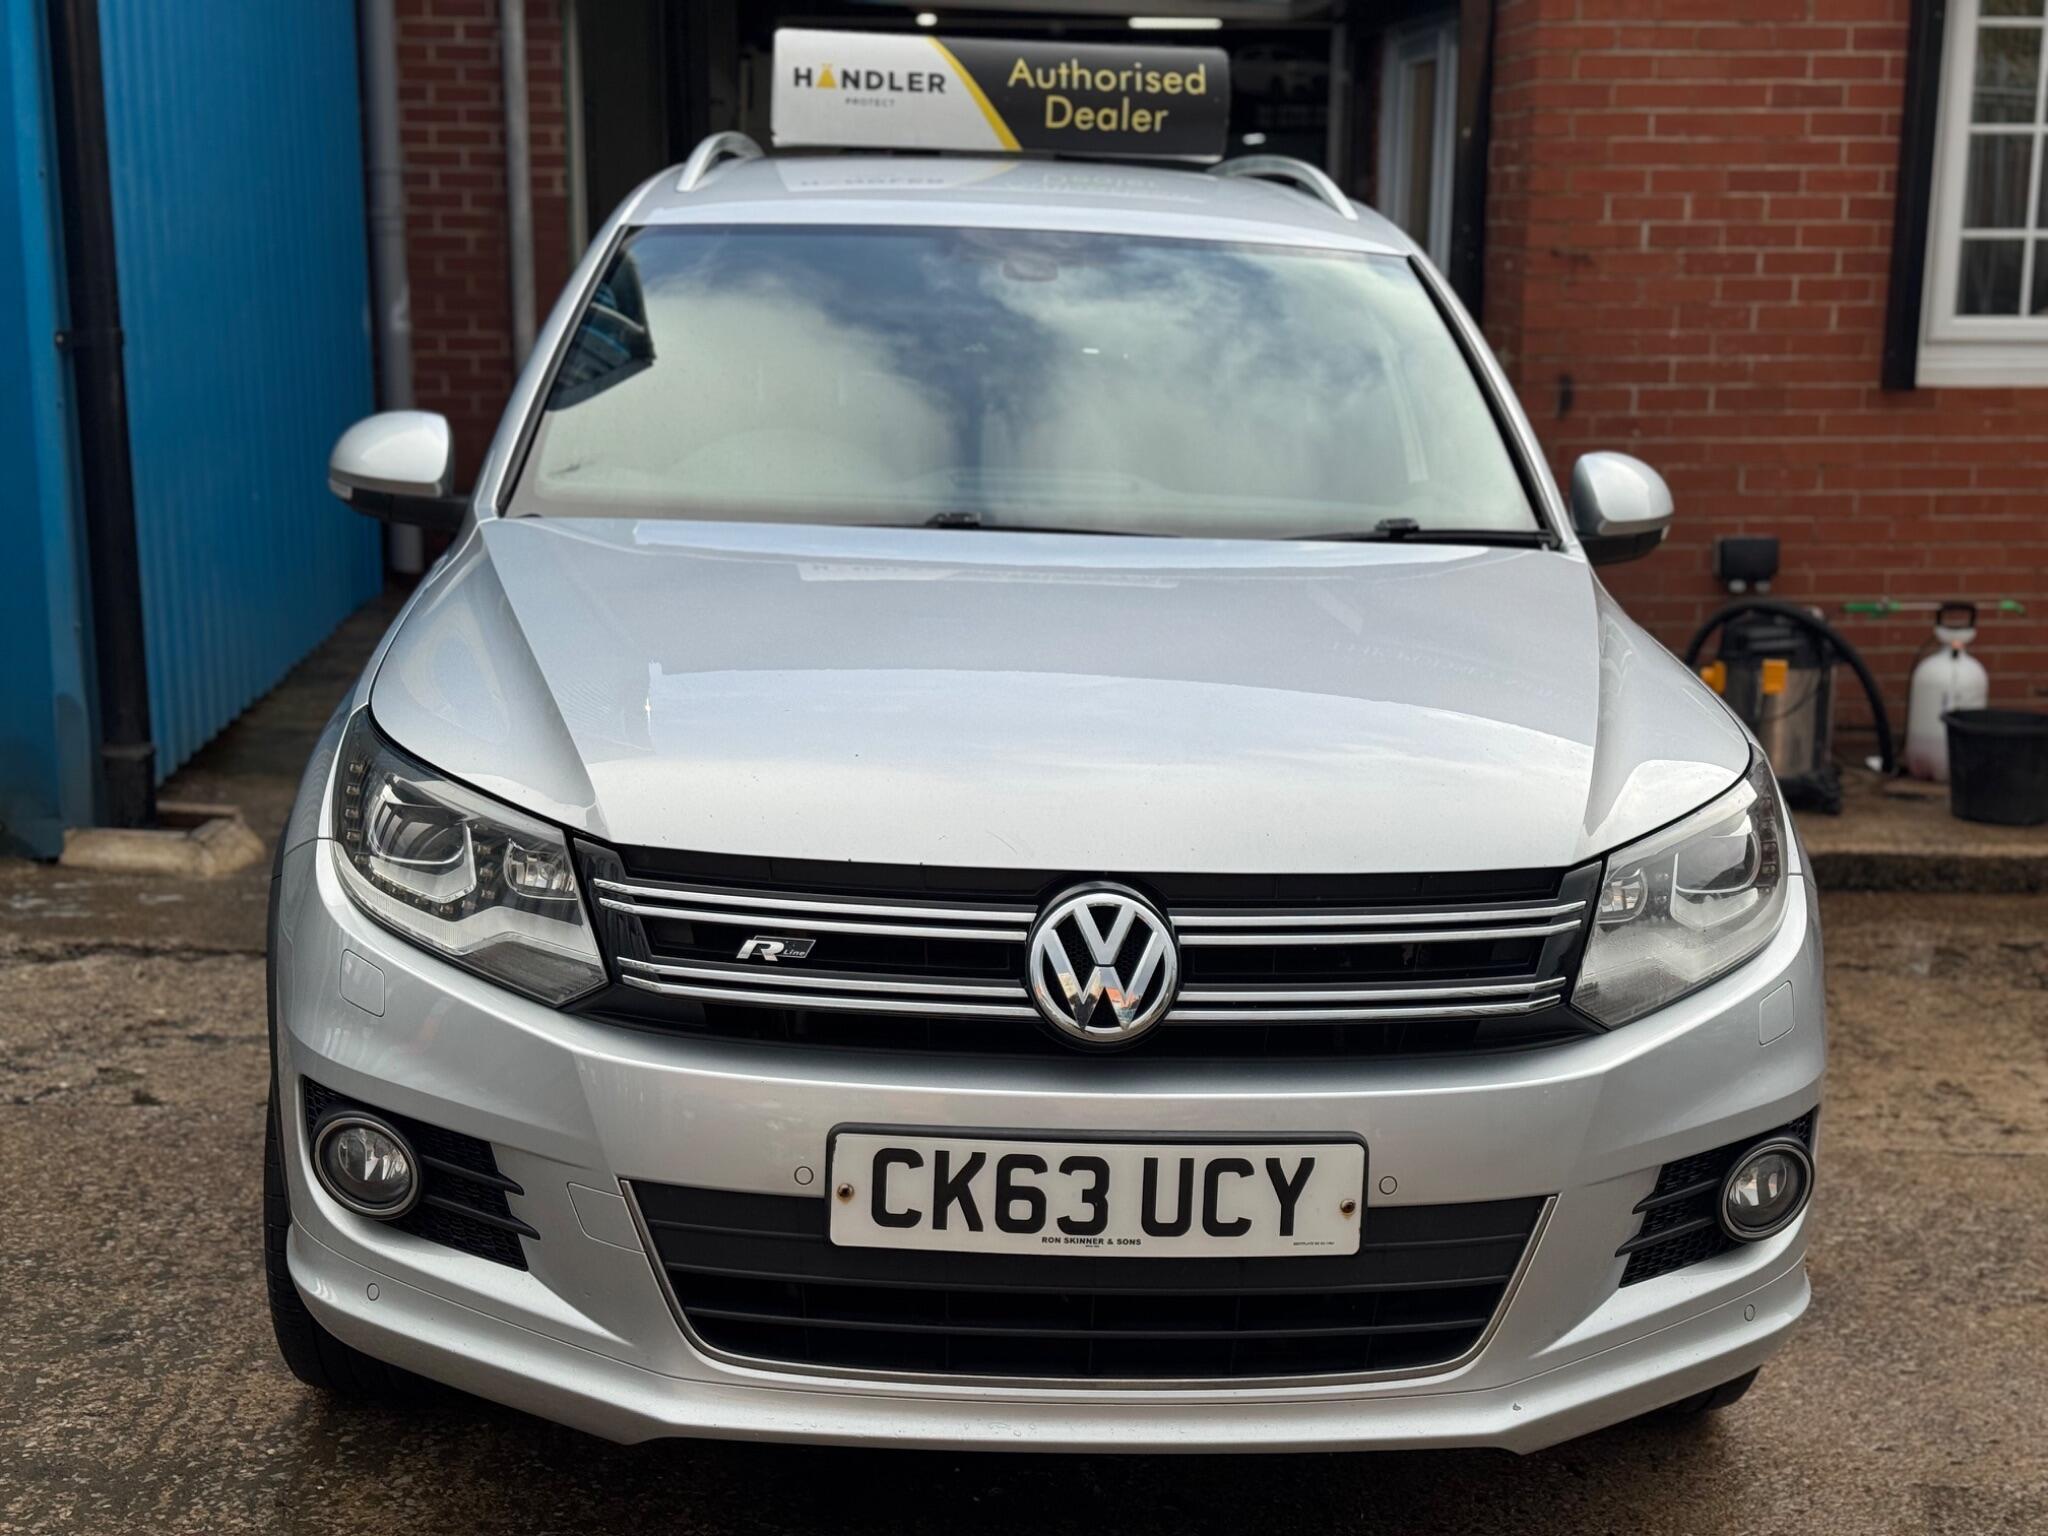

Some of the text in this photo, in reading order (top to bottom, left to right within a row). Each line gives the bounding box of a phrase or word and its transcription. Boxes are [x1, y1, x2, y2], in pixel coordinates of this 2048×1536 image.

[1008, 58, 1207, 95] Authorised
[1045, 95, 1169, 132] Dealer
[736, 939, 784, 961] R
[870, 1147, 1316, 1237] CK63 UCY
[1064, 1237, 1104, 1245] SKINNER
[1117, 1238, 1142, 1246] SONS
